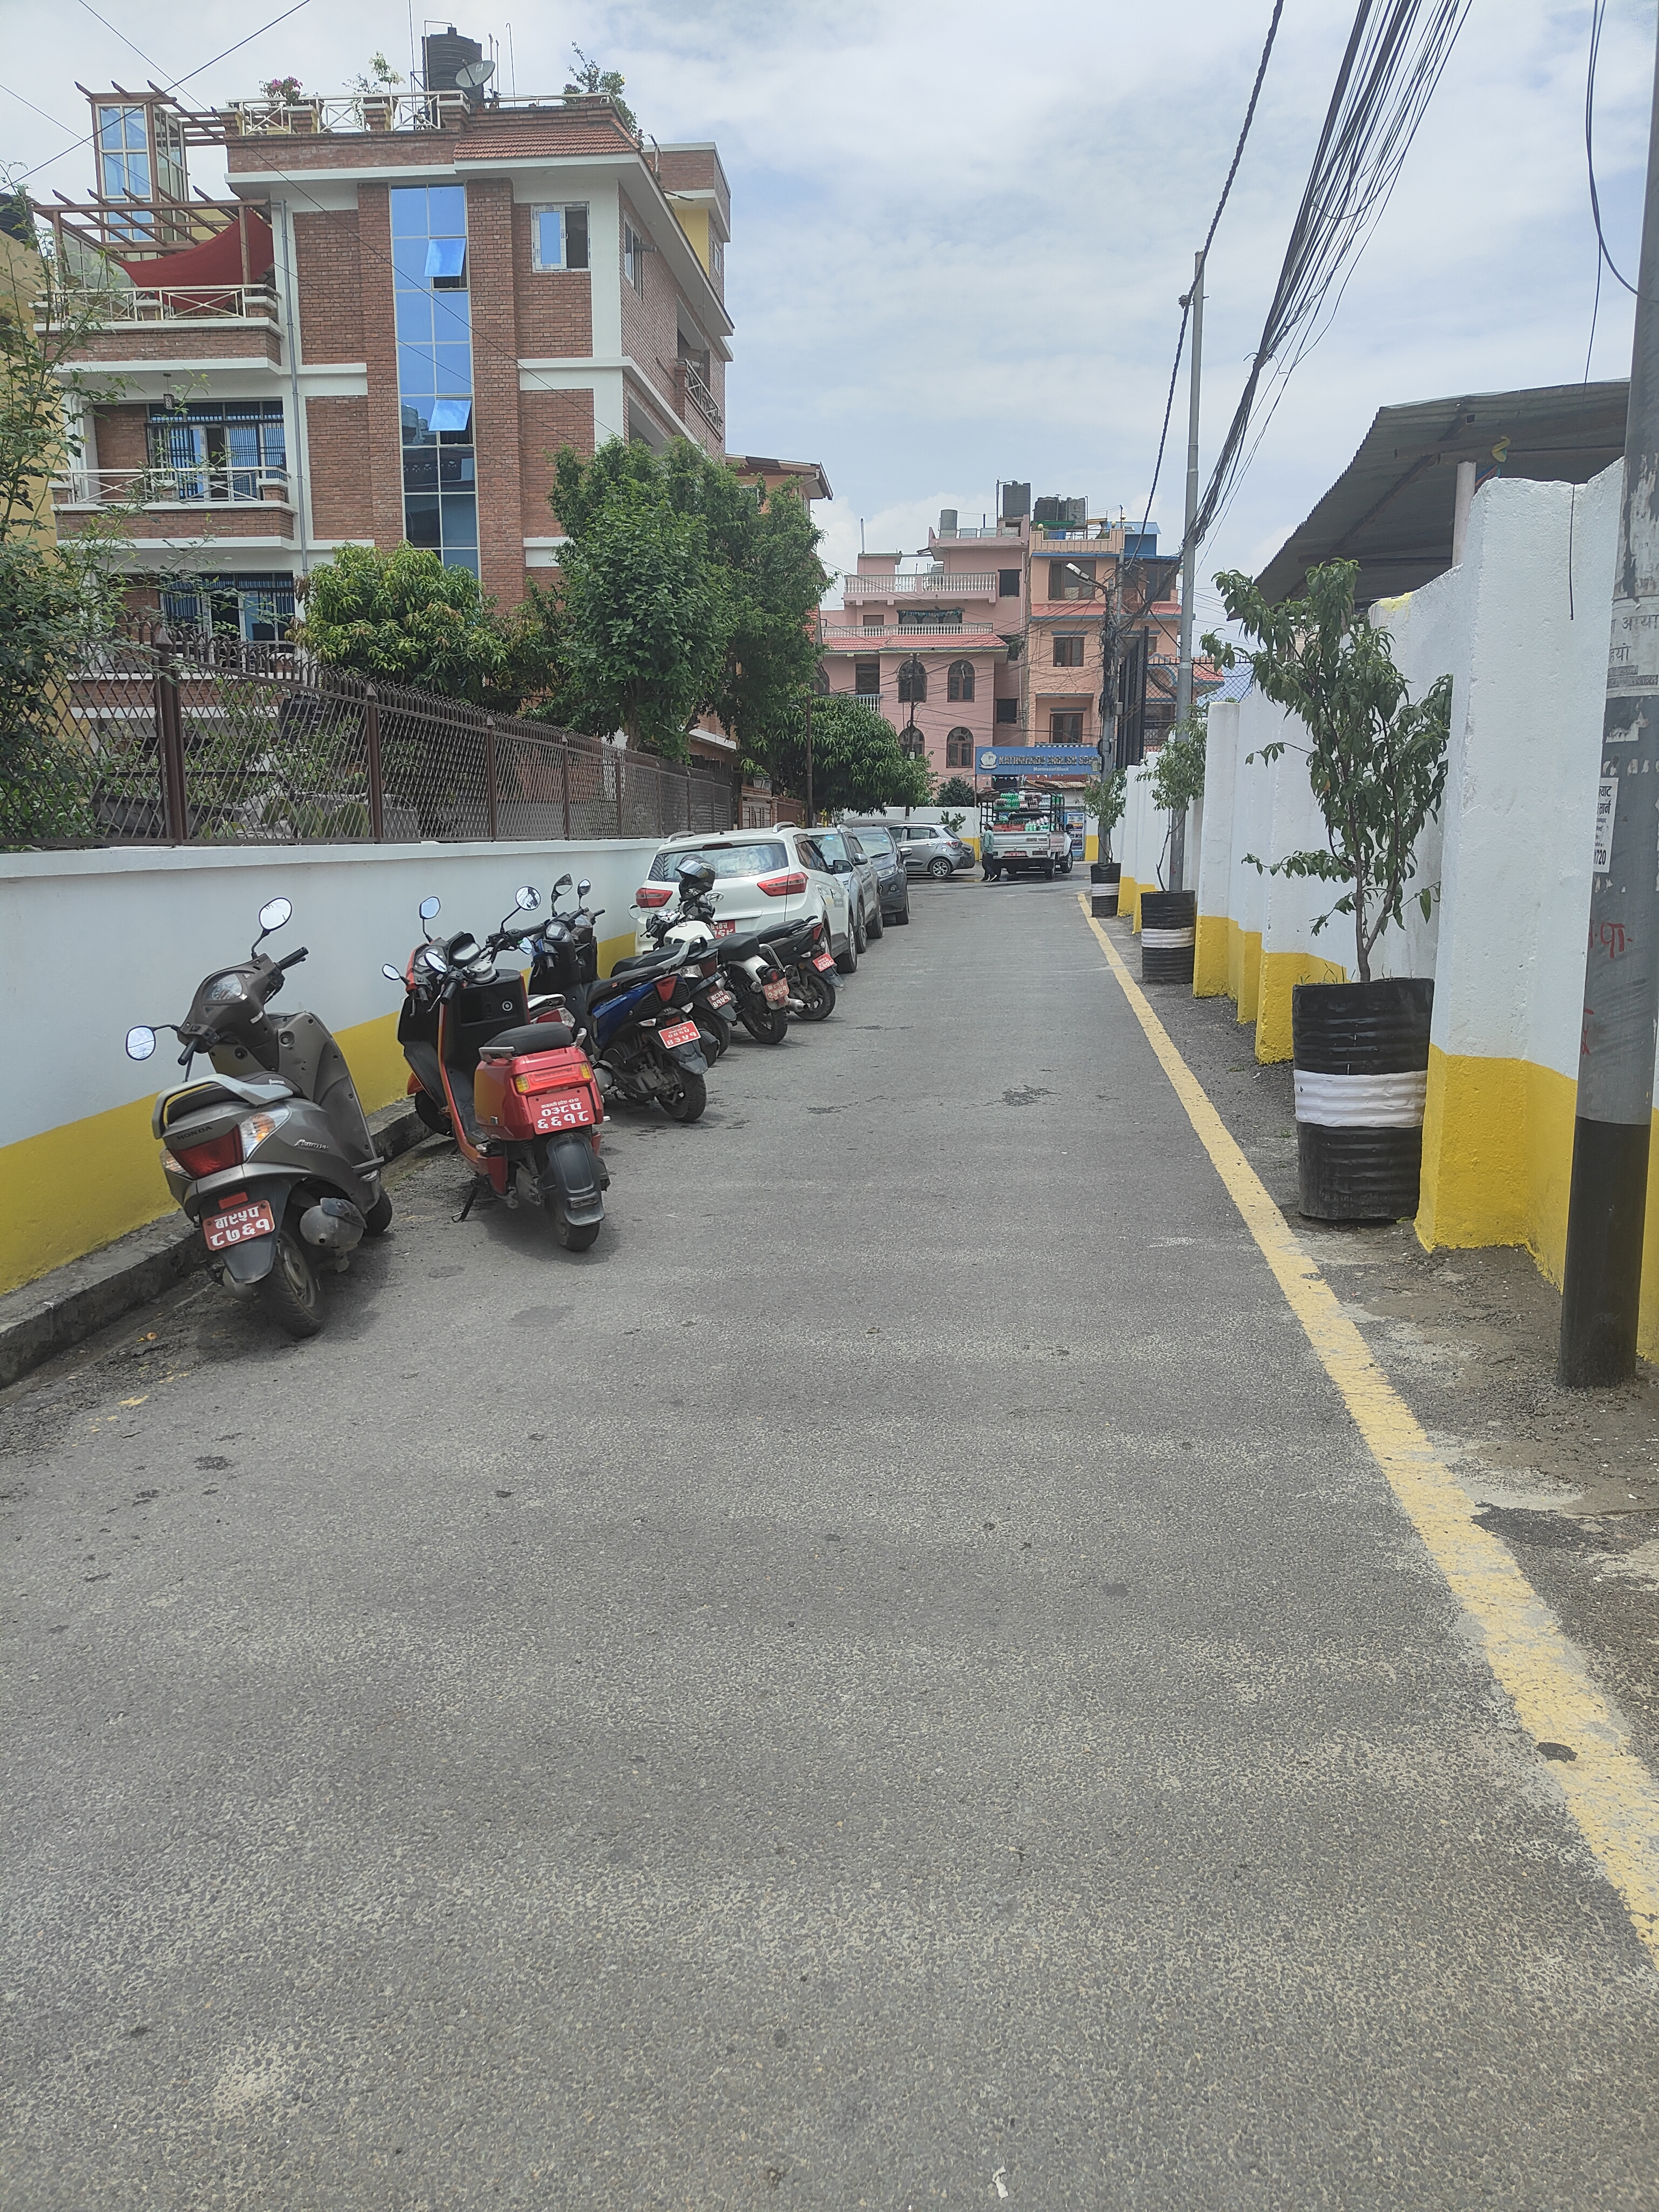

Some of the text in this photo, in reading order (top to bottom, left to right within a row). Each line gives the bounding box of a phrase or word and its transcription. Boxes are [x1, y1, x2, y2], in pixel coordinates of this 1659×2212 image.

[1047, 756, 1077, 765] ENGLISH
[537, 1110, 589, 1129] ६६१८
[177, 1125, 213, 1139] HONDA
[210, 1218, 271, 1246] ८७६१
